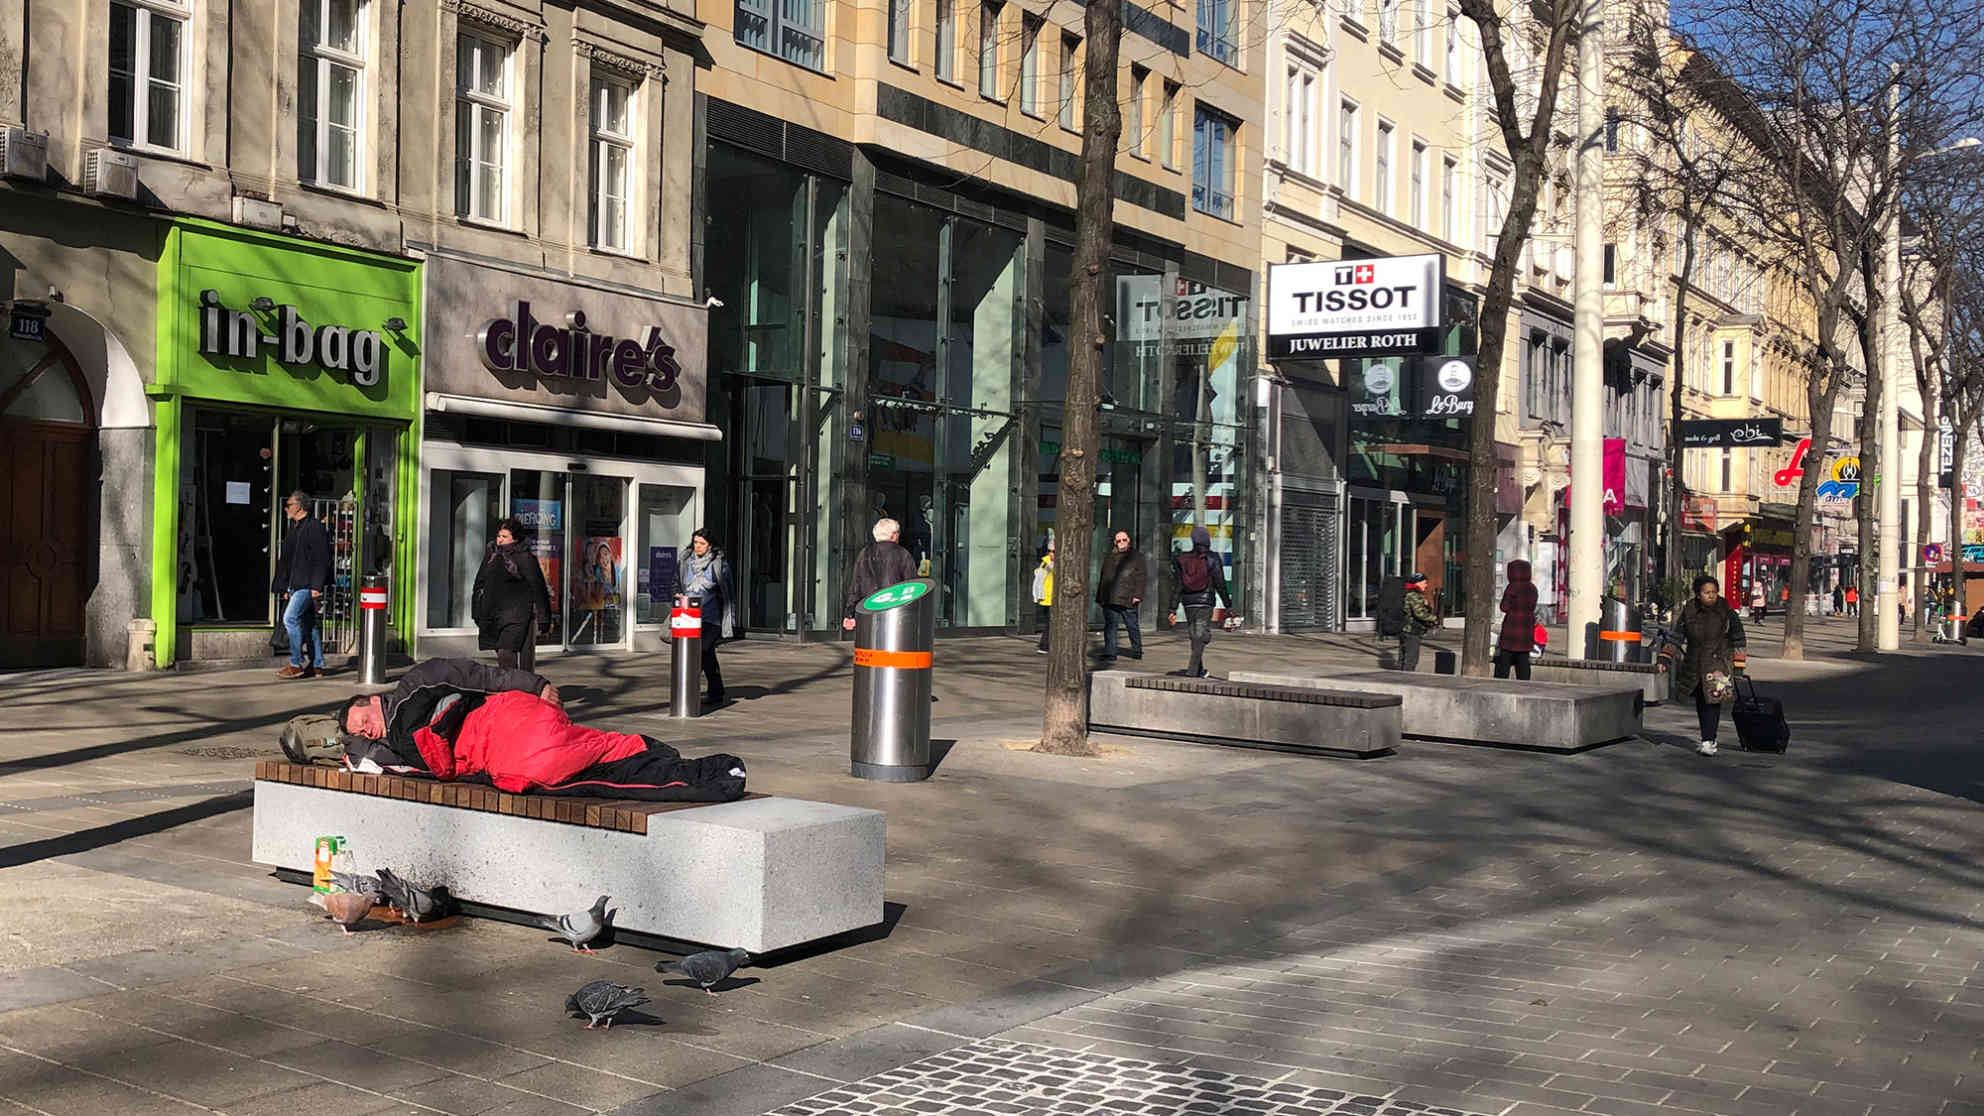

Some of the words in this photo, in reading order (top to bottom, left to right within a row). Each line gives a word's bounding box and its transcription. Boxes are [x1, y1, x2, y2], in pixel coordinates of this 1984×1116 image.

[1292, 285, 1417, 313] TISSOT
[19, 319, 39, 334] 118
[200, 289, 381, 386] in-bag
[478, 300, 680, 393] claire's
[1289, 335, 1367, 354] JUWELIER
[1371, 333, 1417, 348] ROTH
[1425, 395, 1445, 414] Le
[1443, 395, 1474, 414] Burg
